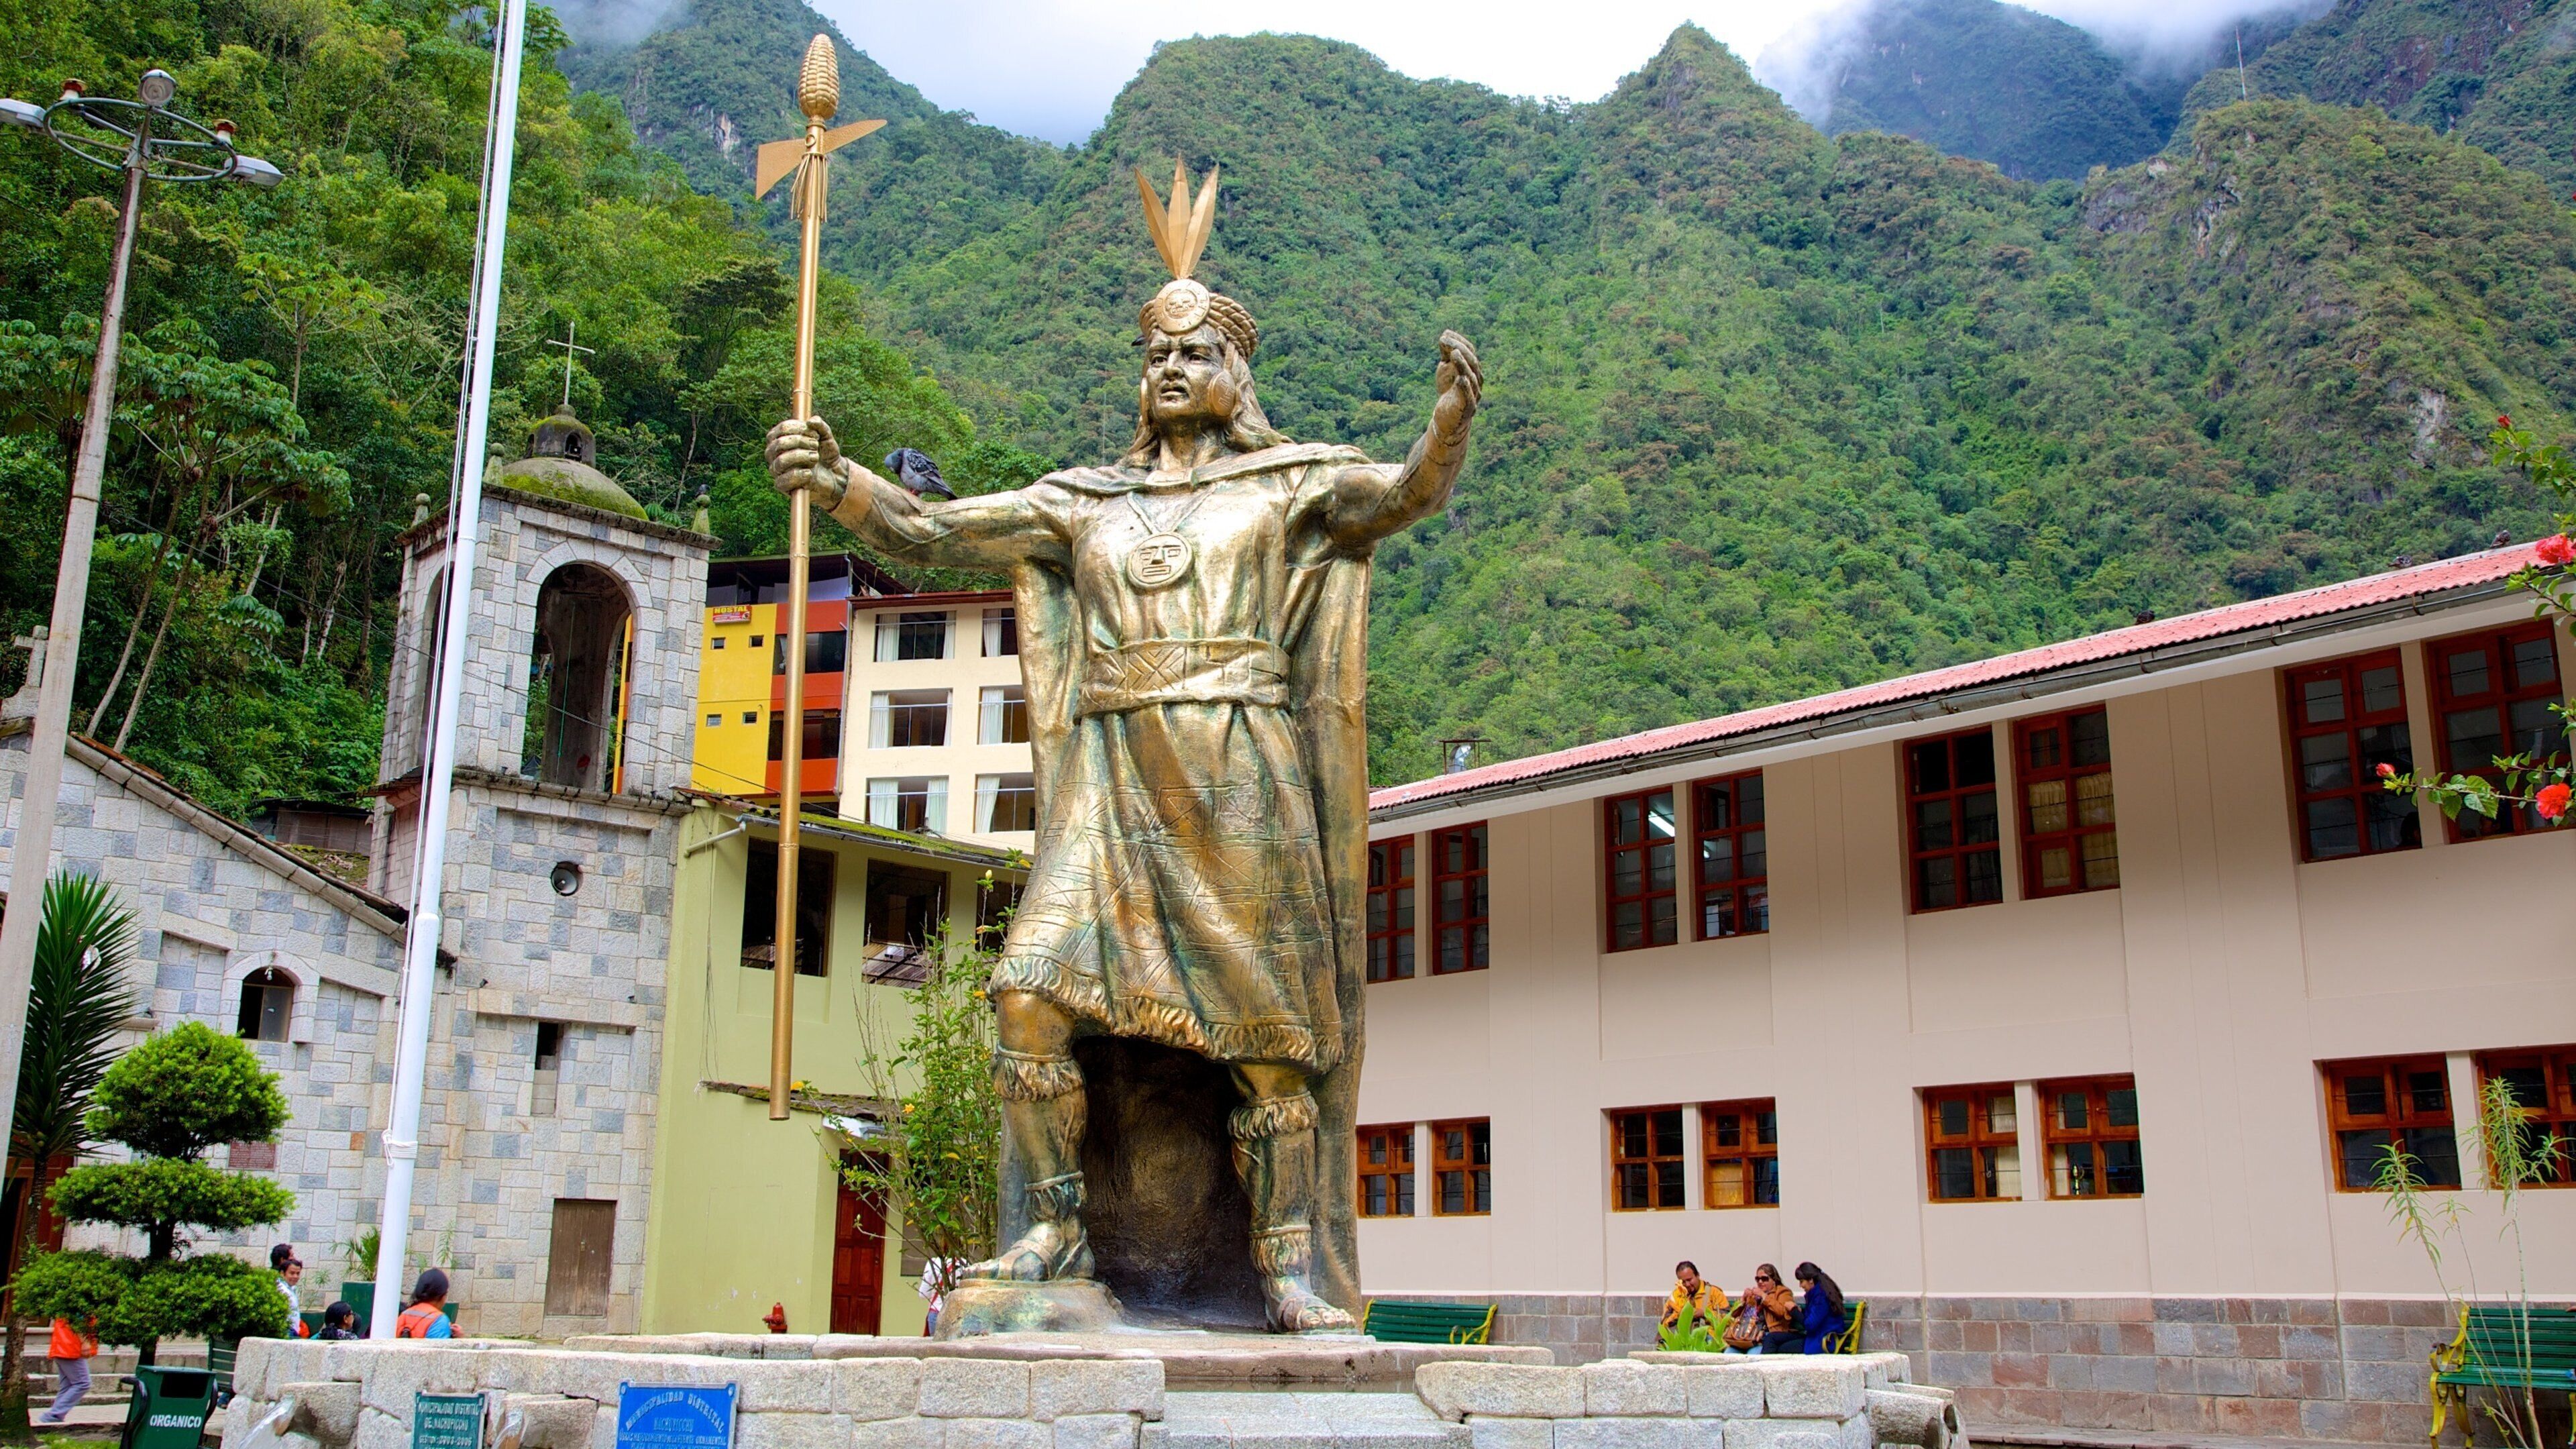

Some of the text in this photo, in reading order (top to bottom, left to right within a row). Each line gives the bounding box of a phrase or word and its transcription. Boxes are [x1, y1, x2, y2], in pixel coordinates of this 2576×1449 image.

[714, 606, 747, 614] HOSTAL
[418, 1401, 480, 1415] MUNICIPALIDAD DISTRITAL
[625, 1391, 725, 1434] MUNICIPALIDAD DISTRITAL
[150, 1414, 201, 1428] ORGANICO
[424, 1417, 433, 1429] DE
